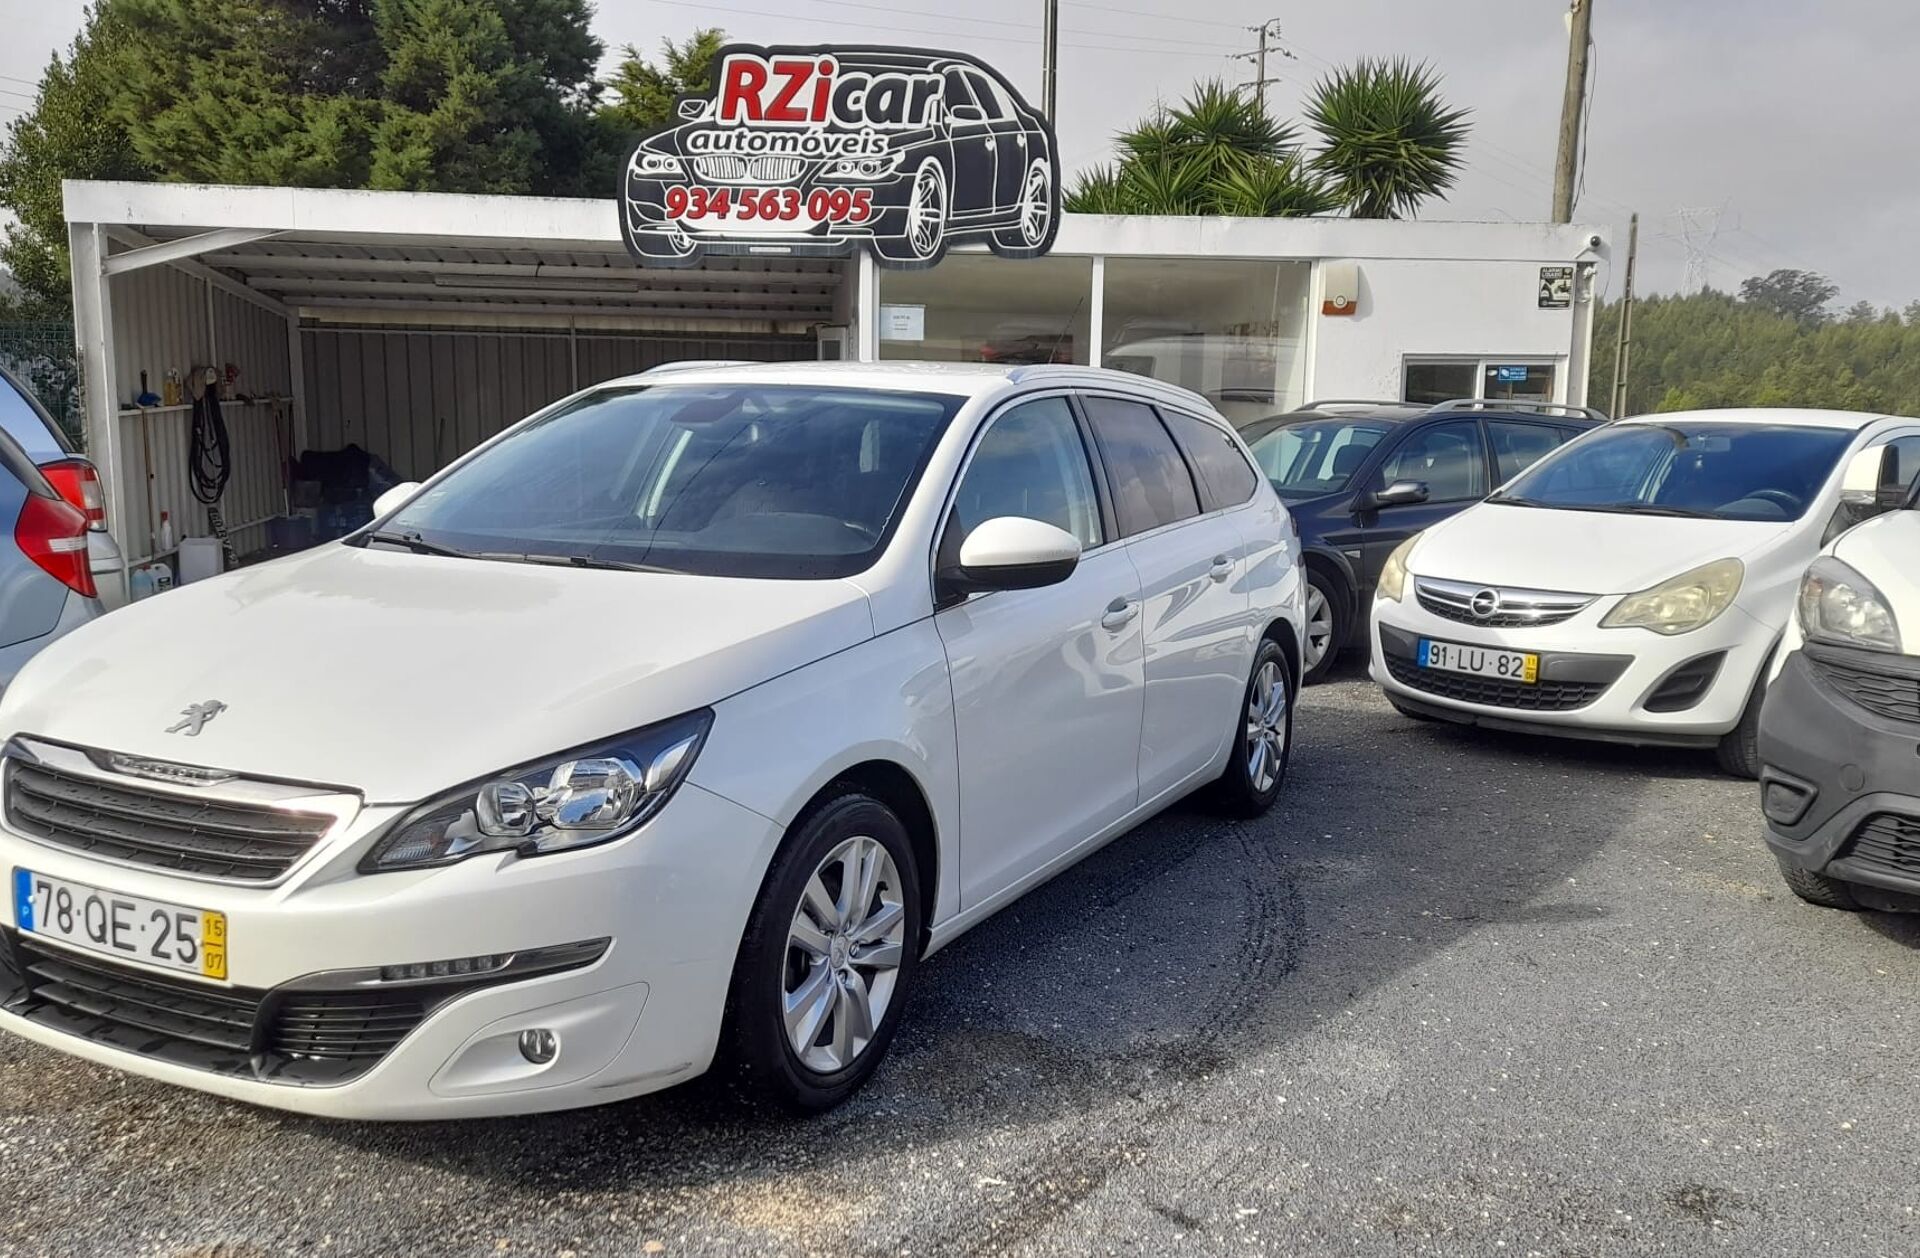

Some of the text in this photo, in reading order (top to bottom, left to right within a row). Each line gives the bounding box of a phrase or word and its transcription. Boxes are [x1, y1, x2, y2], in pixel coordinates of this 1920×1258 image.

[722, 60, 941, 123] RZicar
[691, 128, 886, 153] automóveis
[666, 187, 873, 222] 934 563 095
[206, 919, 223, 937] 15
[206, 952, 223, 970] 07
